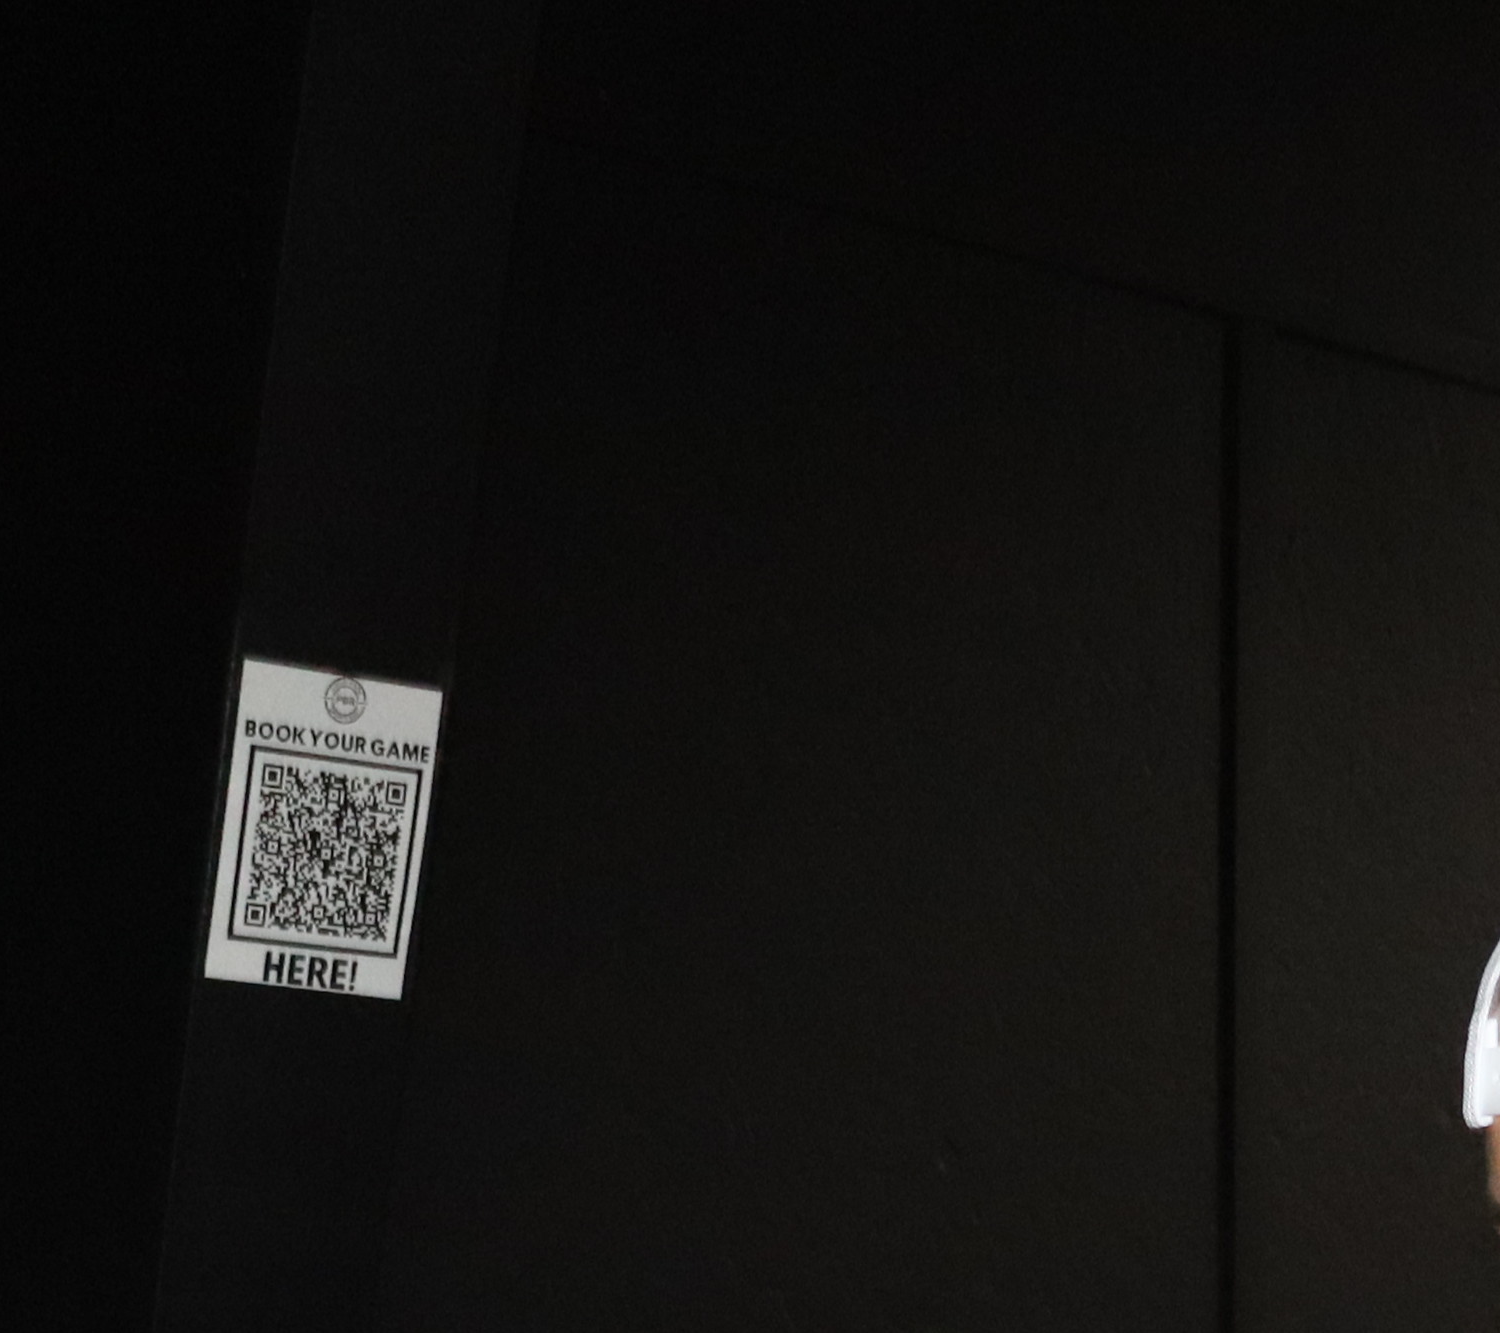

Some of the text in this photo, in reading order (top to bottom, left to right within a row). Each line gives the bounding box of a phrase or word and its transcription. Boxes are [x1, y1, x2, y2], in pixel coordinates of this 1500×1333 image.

[244, 719, 431, 764] BOOK YOUR GAME
[262, 950, 359, 992] HERE!
